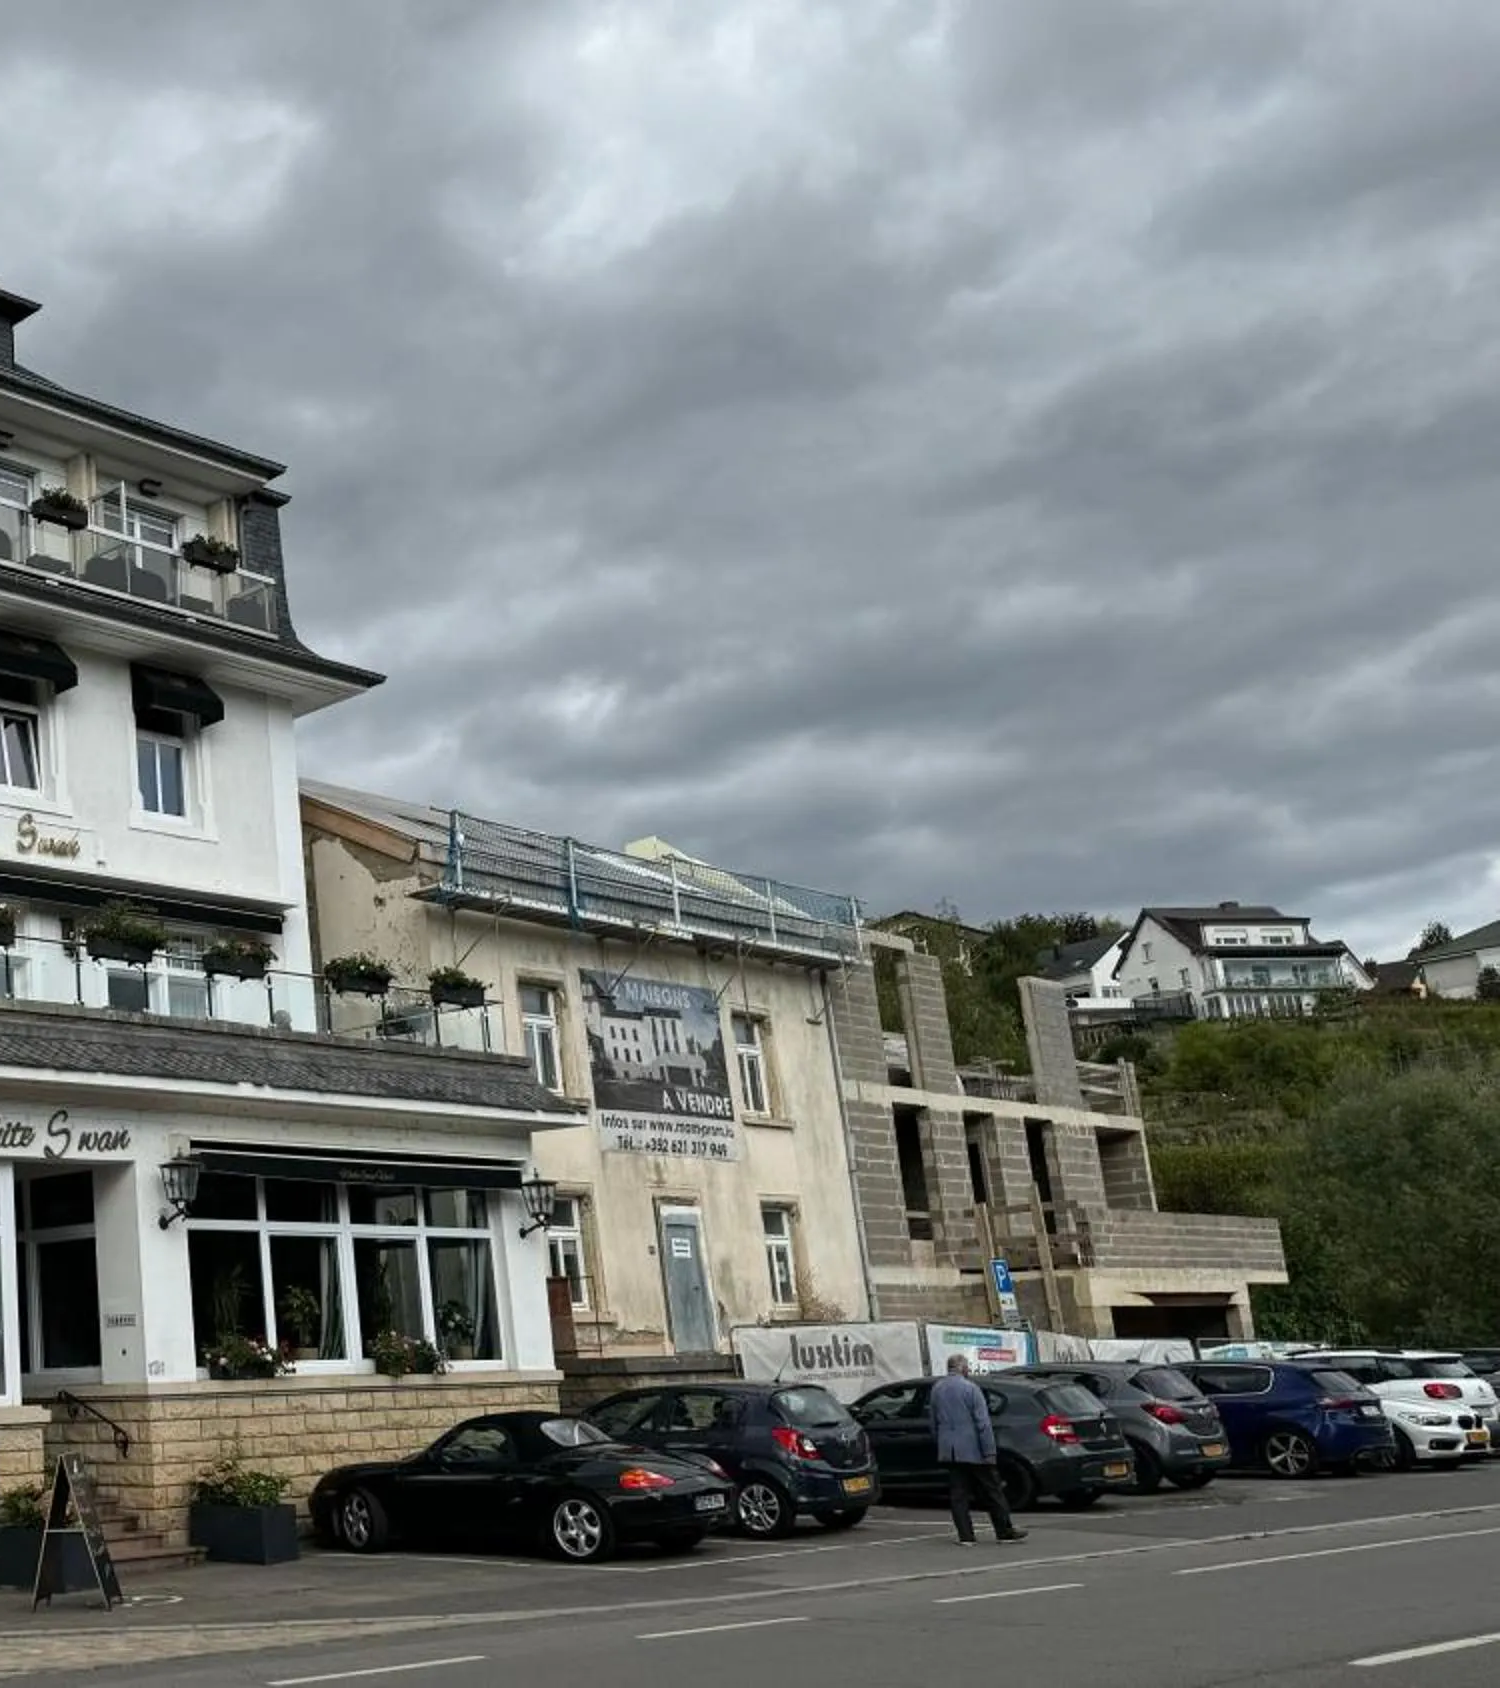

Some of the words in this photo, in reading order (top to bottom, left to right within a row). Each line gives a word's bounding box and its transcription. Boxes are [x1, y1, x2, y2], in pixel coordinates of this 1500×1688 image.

[676, 1089, 732, 1116] VENDRE
[43, 1109, 132, 1159] Swan
[995, 1265, 1007, 1290] P
[789, 1334, 875, 1370] luxtim
